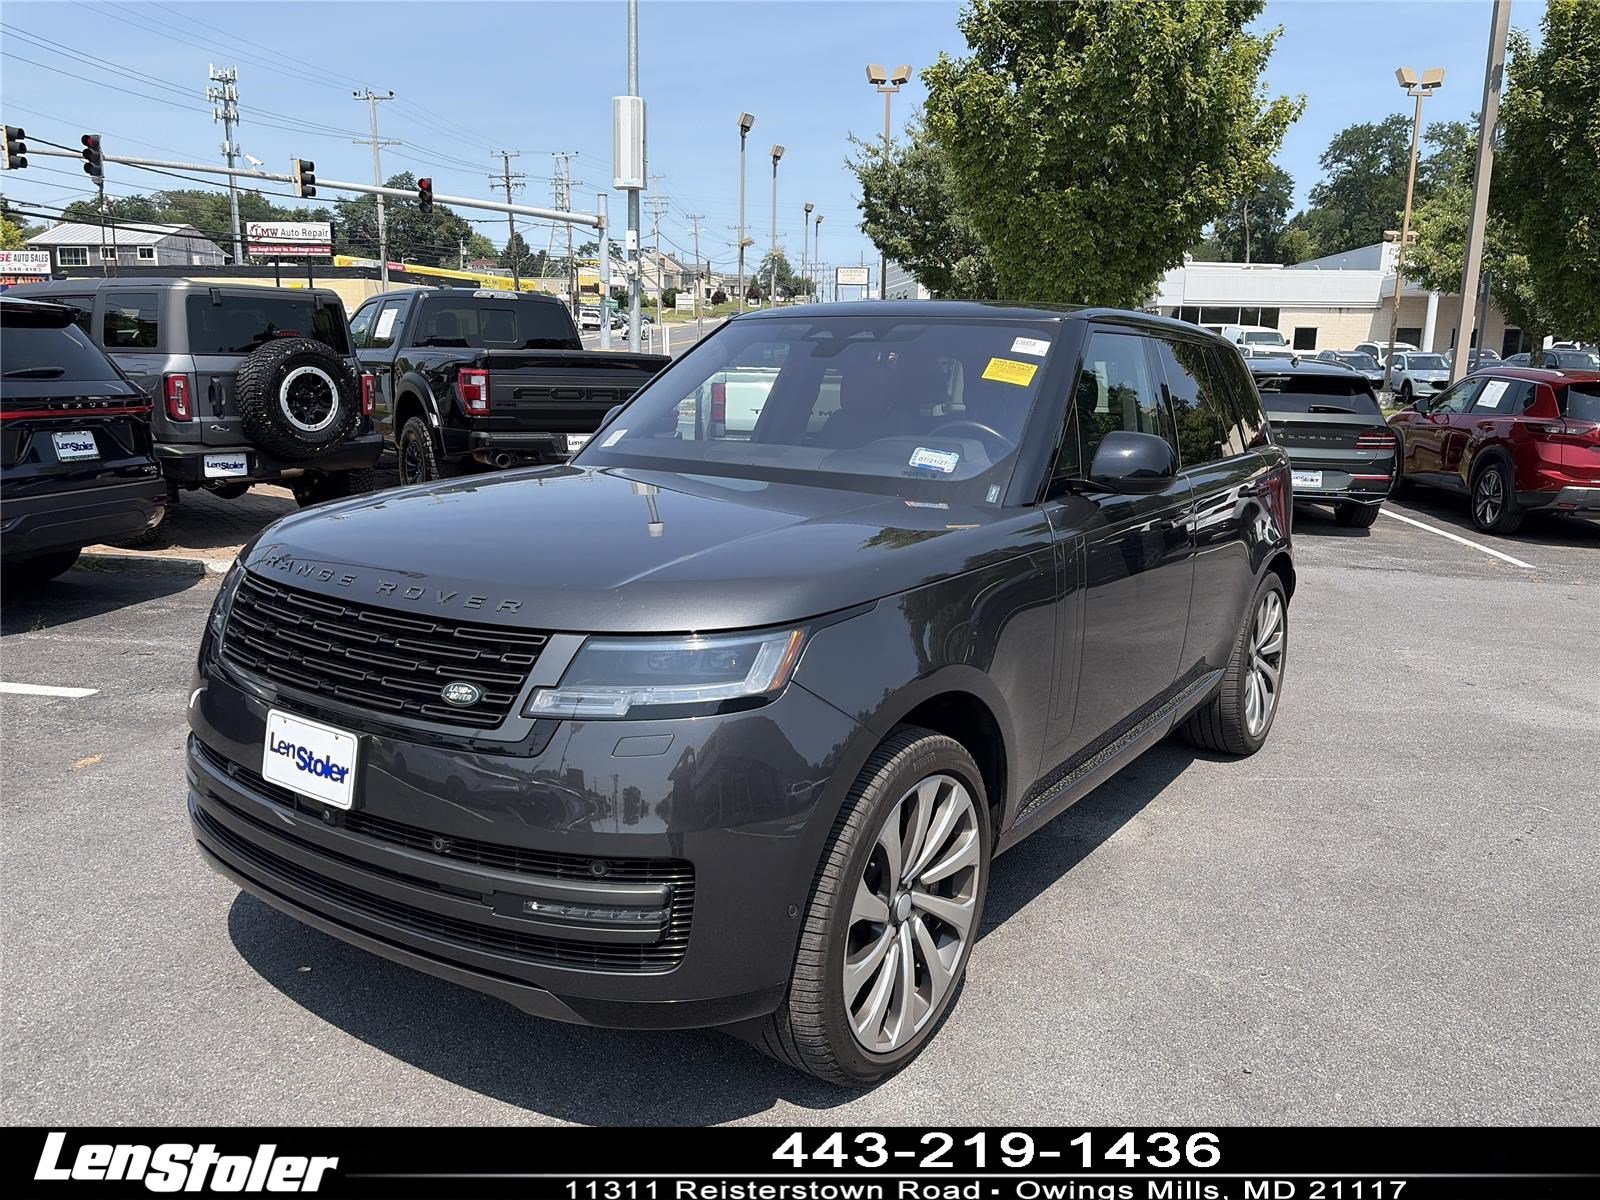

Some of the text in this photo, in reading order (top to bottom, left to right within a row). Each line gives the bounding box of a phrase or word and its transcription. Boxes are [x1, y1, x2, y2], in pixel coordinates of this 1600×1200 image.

[280, 228, 300, 237] Auto
[301, 228, 329, 238] Repair
[14, 254, 29, 262] AUTO
[30, 254, 49, 262] SALES
[48, 401, 109, 409] LEXUS
[57, 441, 94, 452] LenStoler
[206, 461, 245, 470] LenStoler
[265, 556, 523, 614] RANGE ROVER
[270, 732, 349, 784] LenStoler
